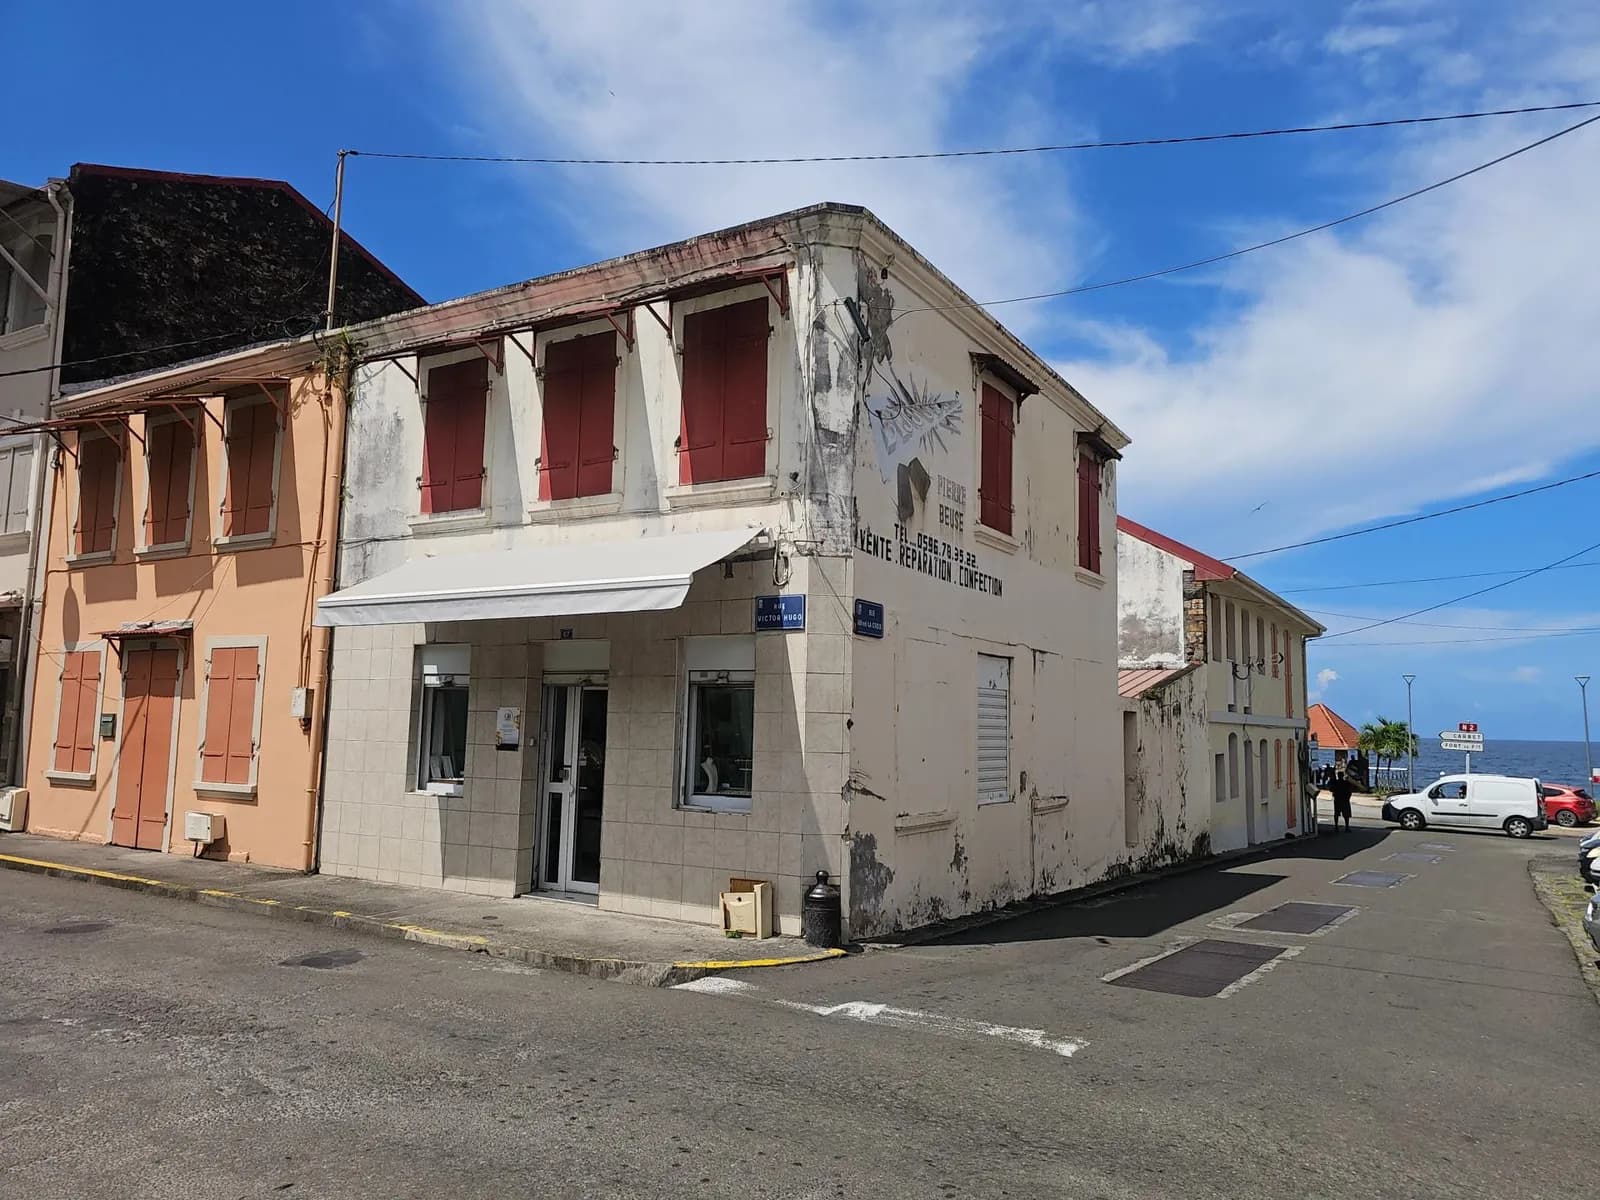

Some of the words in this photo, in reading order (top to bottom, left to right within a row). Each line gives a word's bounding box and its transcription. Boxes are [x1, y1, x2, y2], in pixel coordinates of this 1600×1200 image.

[937, 475, 966, 505] PIERRE
[939, 503, 964, 532] BEUSE
[959, 565, 1003, 597] CONFECTION
[757, 614, 781, 622] VICTOR
[783, 613, 802, 622] HUGO
[773, 602, 786, 610] RUE
